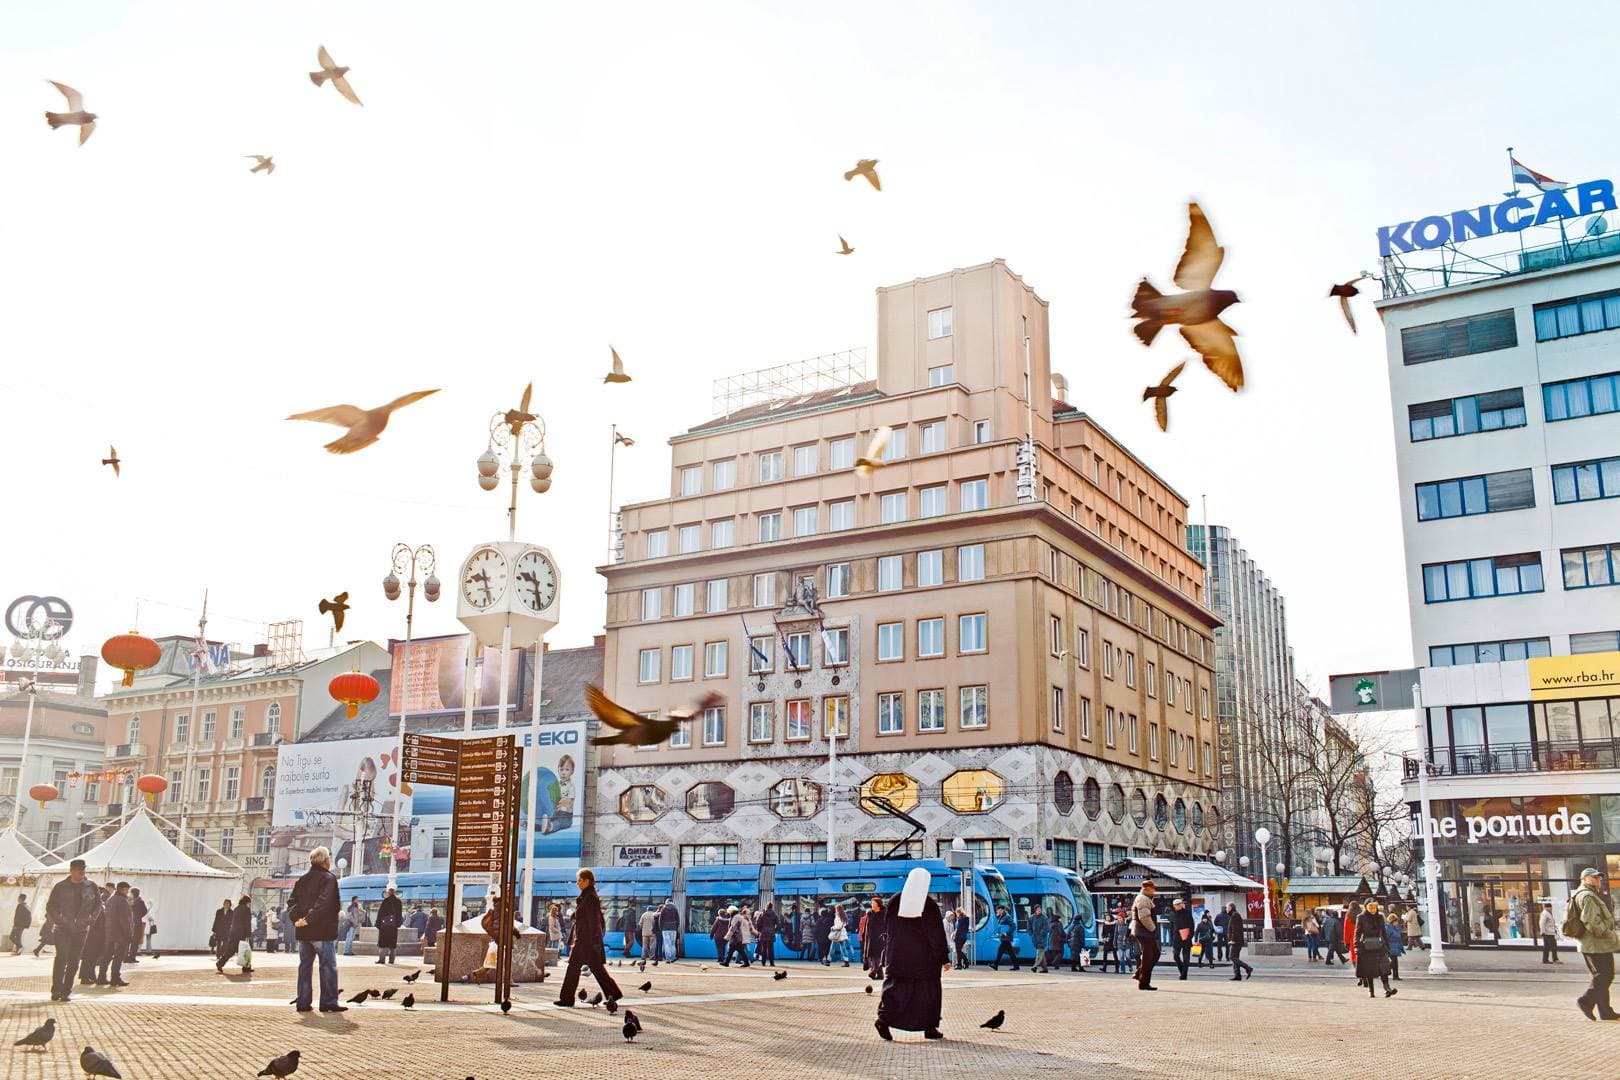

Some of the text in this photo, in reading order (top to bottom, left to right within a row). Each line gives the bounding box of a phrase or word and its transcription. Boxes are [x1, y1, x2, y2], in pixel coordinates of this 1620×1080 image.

[1378, 179, 1617, 257] KONČAR
[1542, 670, 1615, 685] www.rba.hr
[314, 756, 322, 765] se
[1219, 723, 1233, 788] HOTEL
[280, 769, 310, 783] najbolje
[1465, 807, 1592, 844] ponude
[245, 856, 272, 866] SINGE
